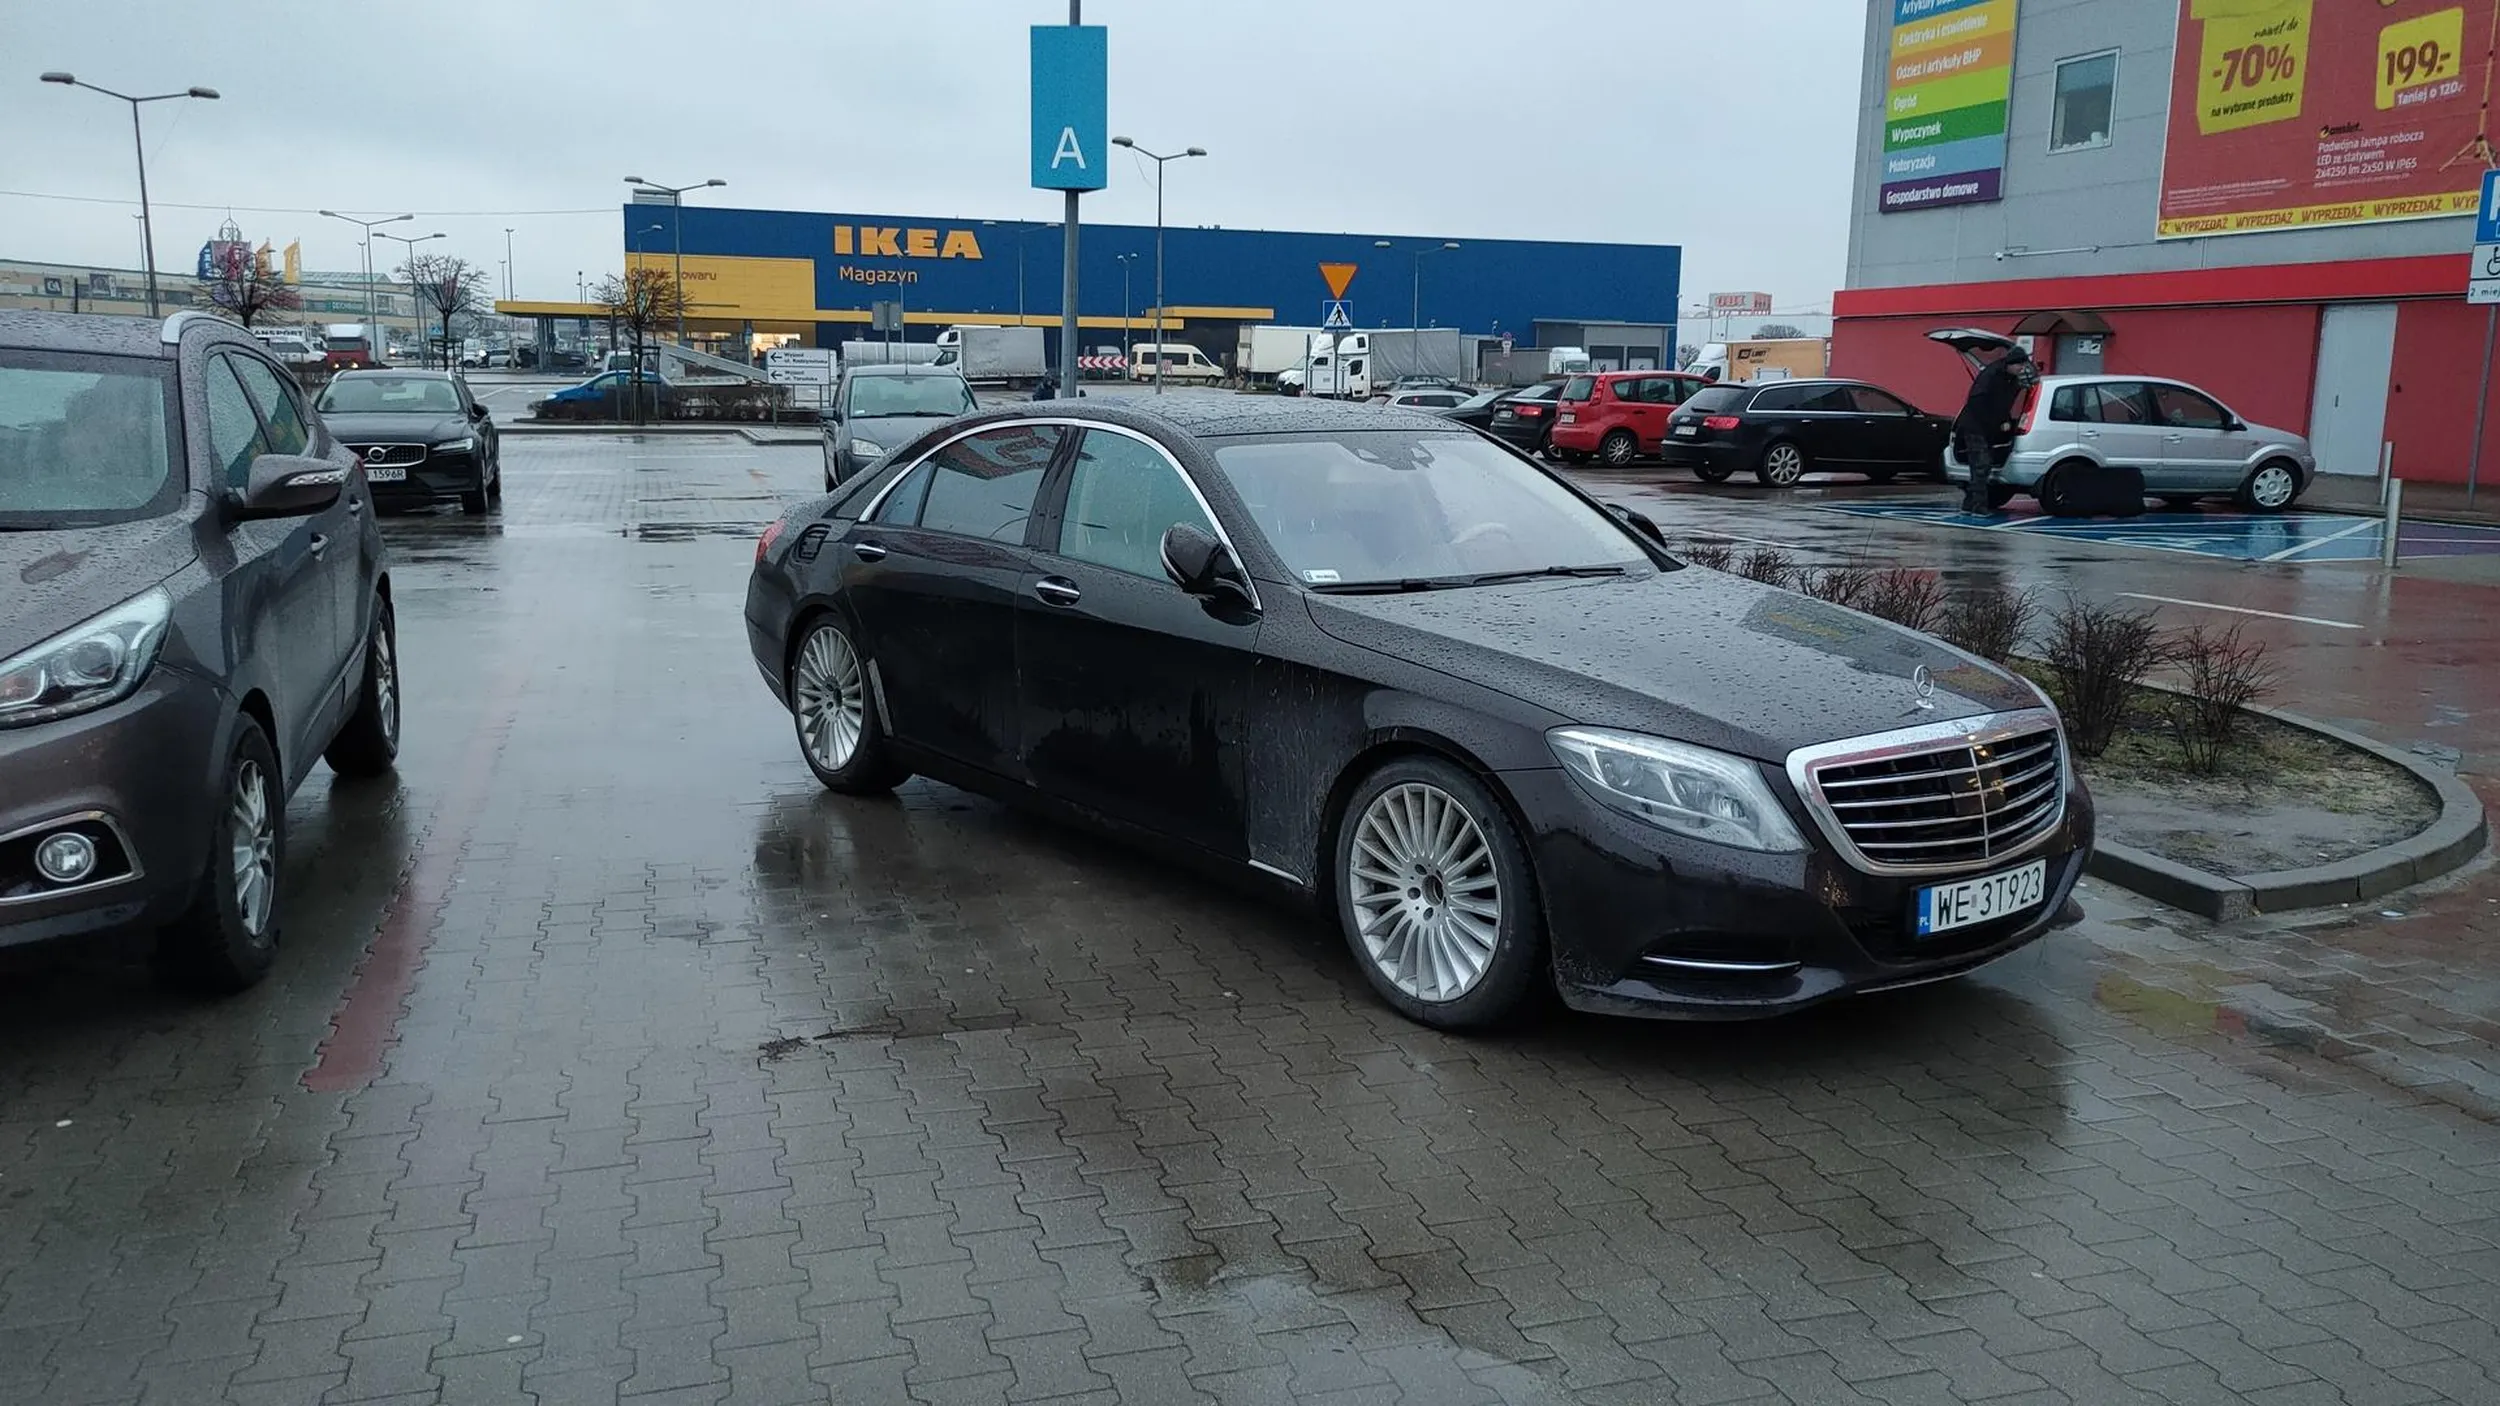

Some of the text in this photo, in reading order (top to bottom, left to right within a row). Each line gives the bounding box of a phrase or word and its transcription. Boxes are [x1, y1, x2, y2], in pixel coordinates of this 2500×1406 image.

[1962, 47, 1982, 66] BHP
[2212, 42, 2295, 94] -70%
[2222, 100, 2257, 117] wybrane
[2257, 92, 2295, 111] produkty
[2397, 86, 2428, 106] Taniej
[2429, 87, 2438, 99] o
[1891, 120, 1942, 144] Wypoczynek
[2360, 136, 2389, 149] lampa
[2389, 131, 2425, 145] robocza
[1051, 126, 1087, 169] A
[1888, 154, 1937, 174] Motoryzacja
[2314, 165, 2348, 179] 2x4250
[2348, 164, 2360, 175] lm
[2385, 160, 2396, 171] W
[2396, 157, 2418, 171] IP65
[2317, 154, 2332, 167] LED
[1885, 181, 1980, 206] Gospodarstwo domowe
[2235, 211, 2294, 228] WYPRZEDAŻ
[2301, 205, 2365, 223] WYPRZEDAŻ
[2373, 198, 2443, 217] WYPRZEDAŻ
[834, 225, 983, 259] IKEA
[679, 270, 718, 281] owaru
[839, 265, 919, 286] Magazyn
[1937, 865, 2042, 927] WE 3T923
[1919, 915, 1930, 928] PL
